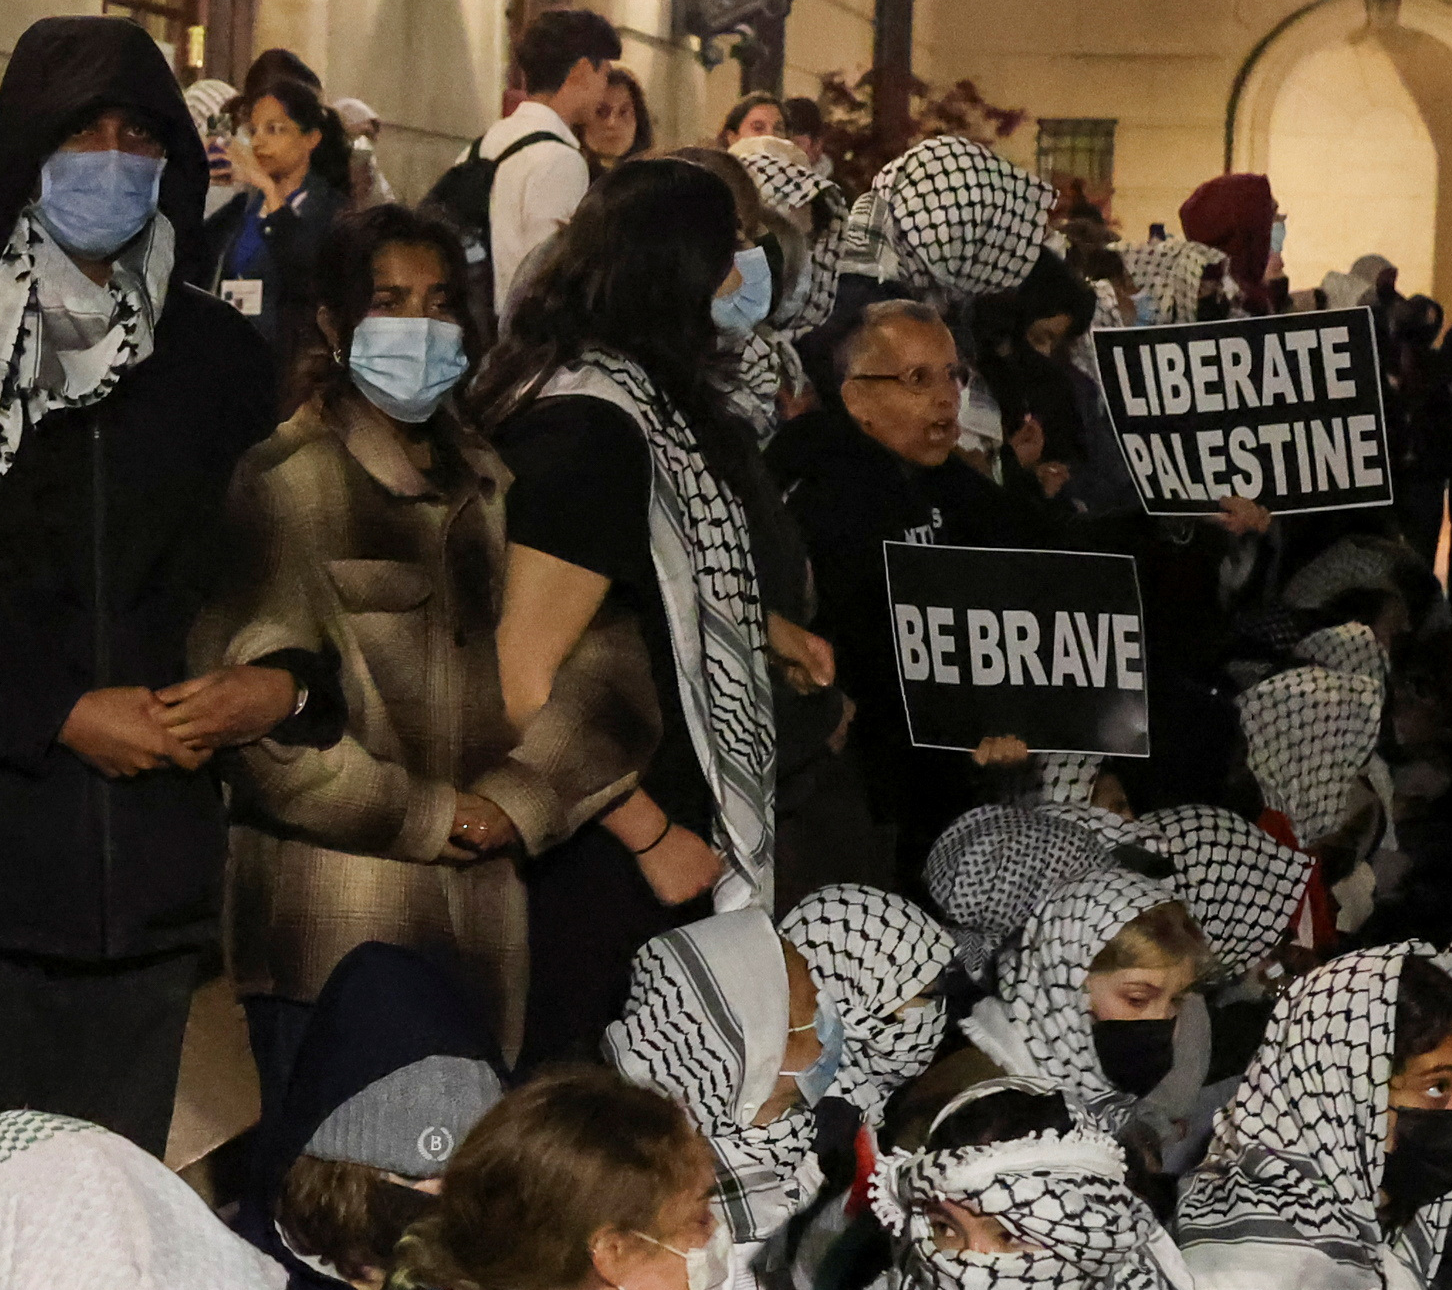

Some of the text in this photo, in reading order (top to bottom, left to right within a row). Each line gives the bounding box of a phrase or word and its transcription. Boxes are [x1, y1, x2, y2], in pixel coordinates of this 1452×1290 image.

[1112, 325, 1357, 418] LIBERATE
[1122, 414, 1384, 502] PALESTINE
[894, 603, 1144, 691] BE BRAVE
[430, 1135, 442, 1151] B
